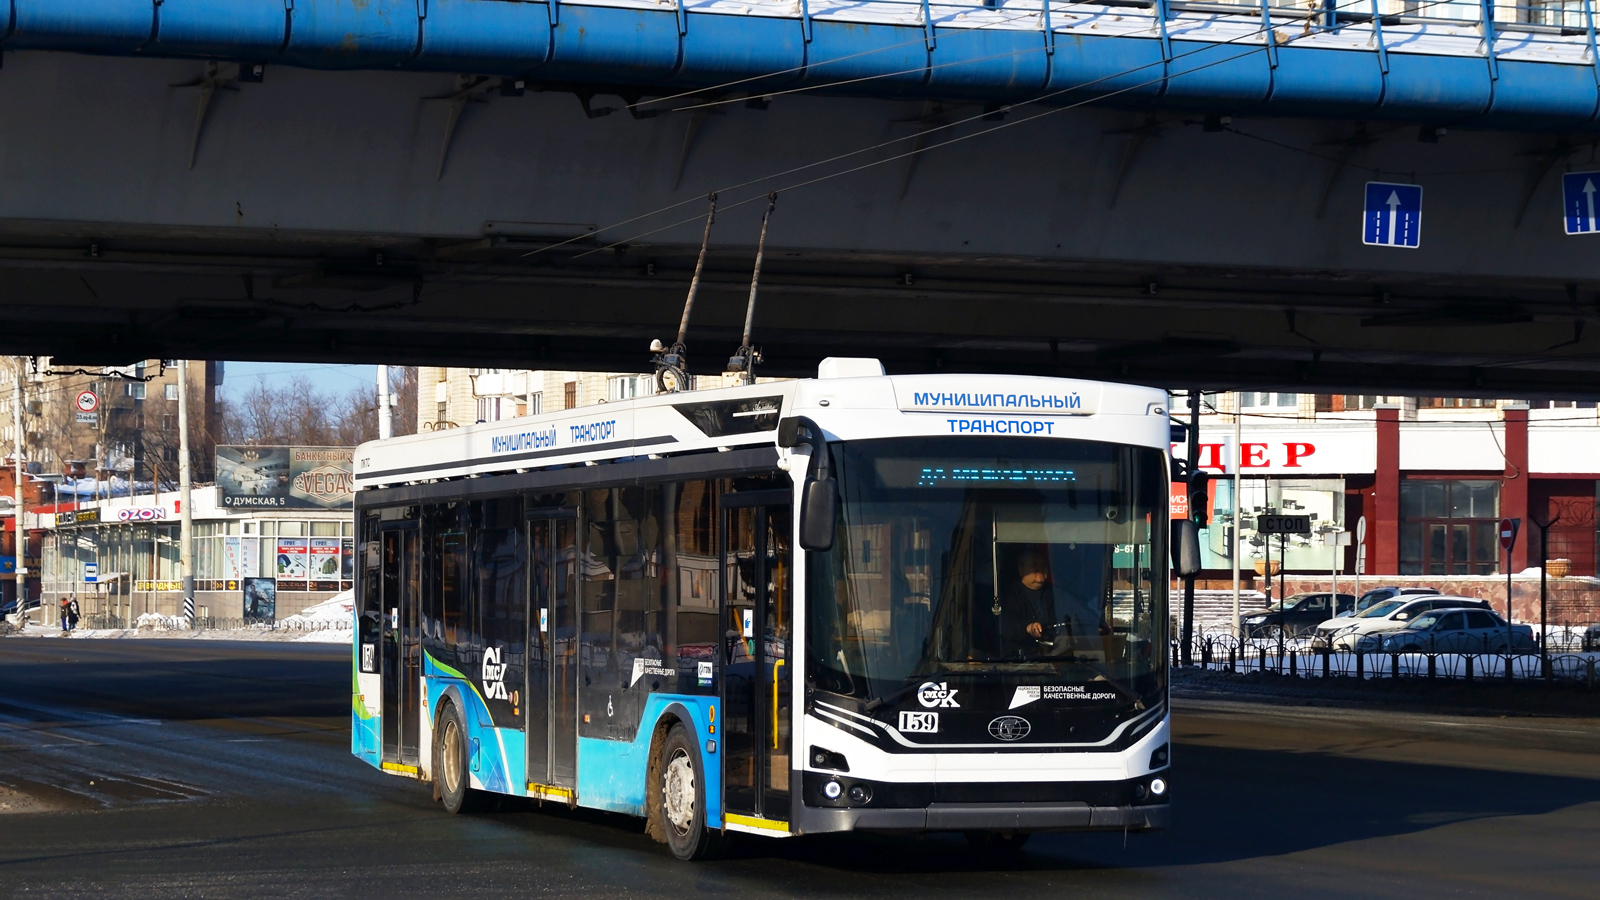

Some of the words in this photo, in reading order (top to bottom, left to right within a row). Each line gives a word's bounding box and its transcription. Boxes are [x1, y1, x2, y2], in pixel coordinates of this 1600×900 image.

[914, 391, 1081, 408] МУНИЦИПАЛЬНЫЙ
[947, 419, 1054, 434] ТРАНСПОРТ
[491, 425, 557, 453] МУНИЦИПАЛЬНЫЙ
[570, 420, 616, 444] ТРАНСПОРТ
[1171, 443, 1316, 474] ДЕР
[233, 497, 278, 506] ДУМСКАЯ,
[279, 497, 285, 505] 5
[118, 507, 166, 521] OZON
[1265, 518, 1303, 530] СТОП
[363, 644, 374, 671] 159
[901, 713, 936, 732] 159
